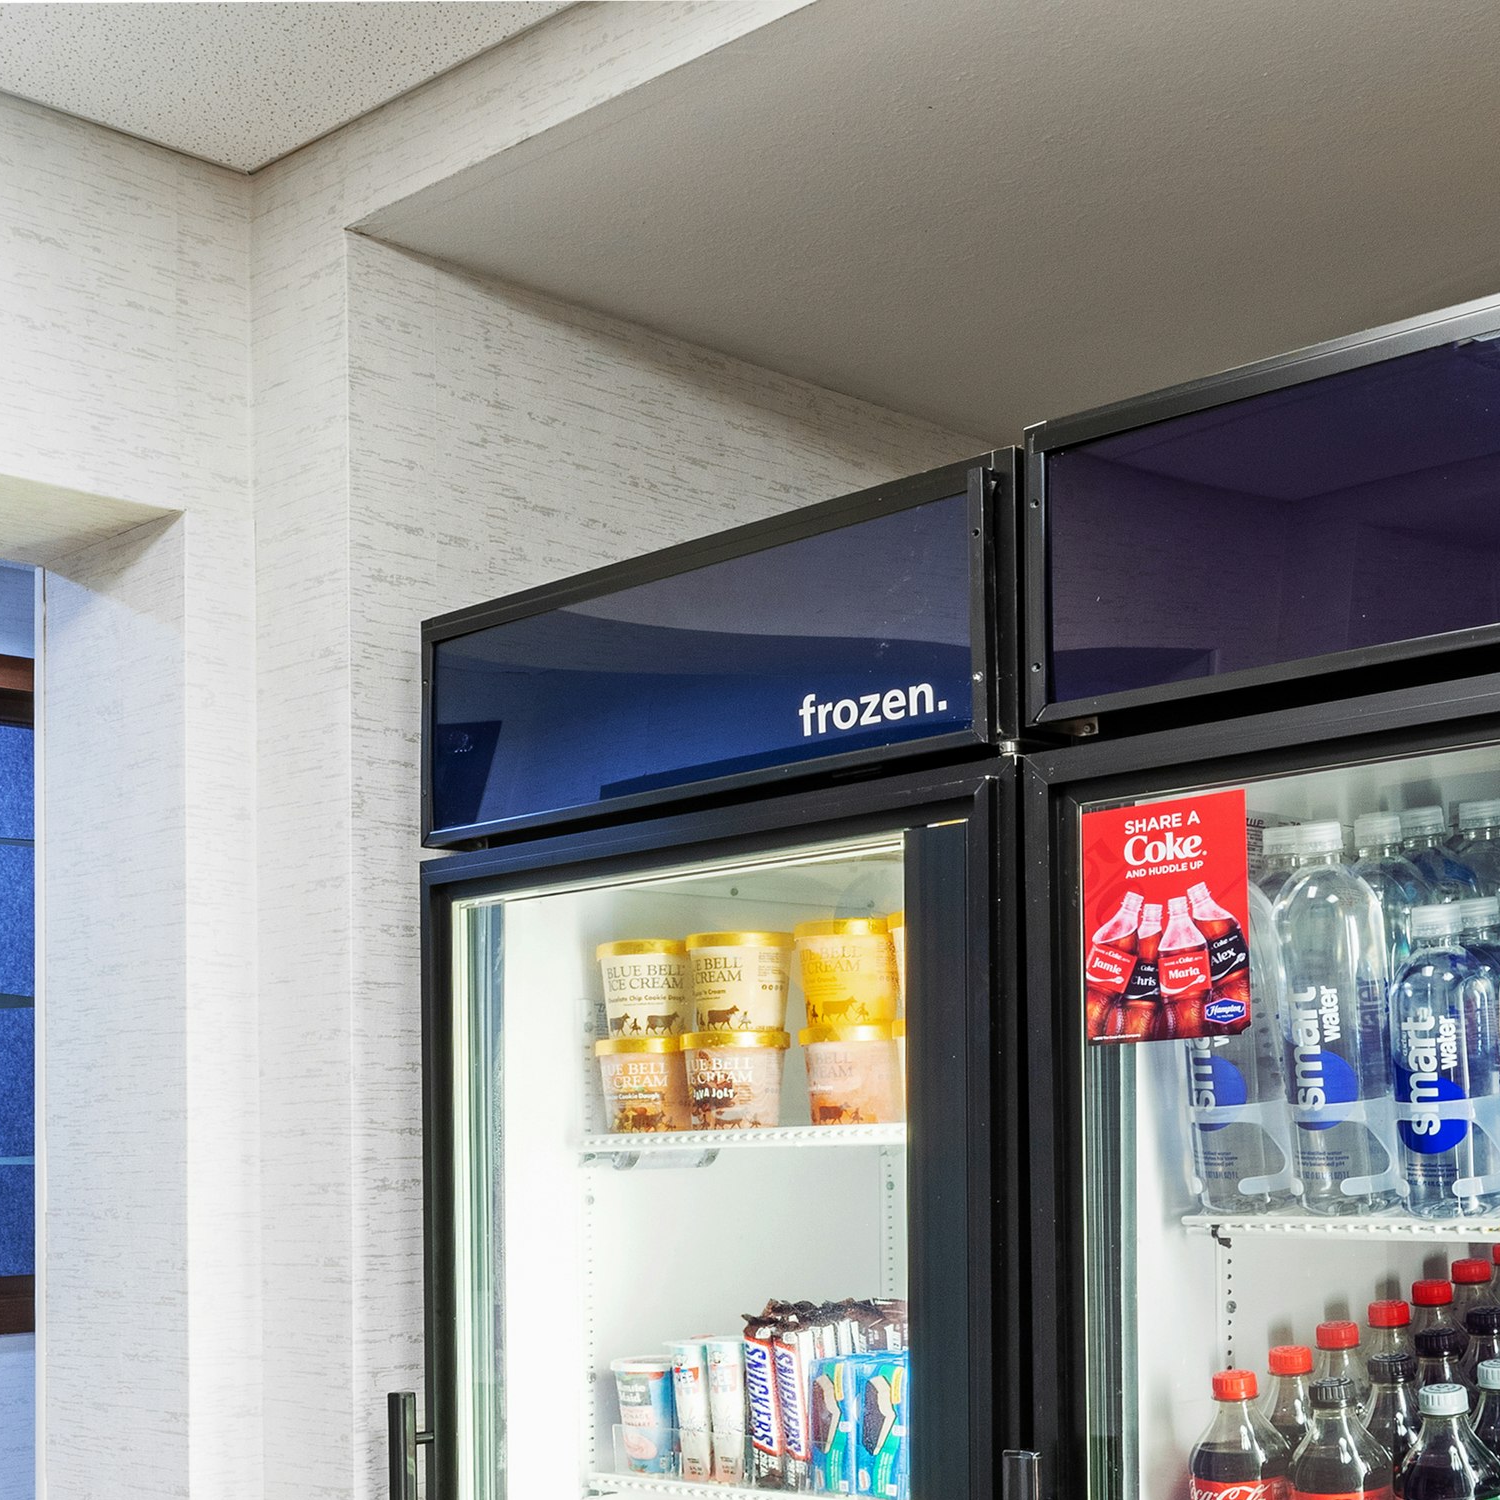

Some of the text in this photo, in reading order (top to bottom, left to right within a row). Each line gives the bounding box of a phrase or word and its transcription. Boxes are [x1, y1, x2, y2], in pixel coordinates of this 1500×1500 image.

[798, 681, 947, 737] frozen.
[1124, 811, 1200, 834] SHARE A
[1125, 860, 1204, 878] AND HUDDLE UP
[704, 956, 743, 969] BELL
[1211, 947, 1236, 966] Alex
[607, 964, 685, 980] BLUE BELL
[1092, 958, 1122, 975] Jamie
[1168, 967, 1200, 979] Maria
[629, 976, 684, 990] CREAM
[696, 970, 742, 984] CREAM
[1132, 976, 1156, 986] Chris
[1207, 1005, 1244, 1017] Hampton
[1292, 985, 1341, 1112] smart water
[627, 1062, 669, 1075] BELL
[1401, 1015, 1458, 1136] smart water
[711, 1087, 734, 1099] JOLT
[745, 1343, 774, 1449] SNICKERS
[775, 1350, 802, 1453] SNICKERS
